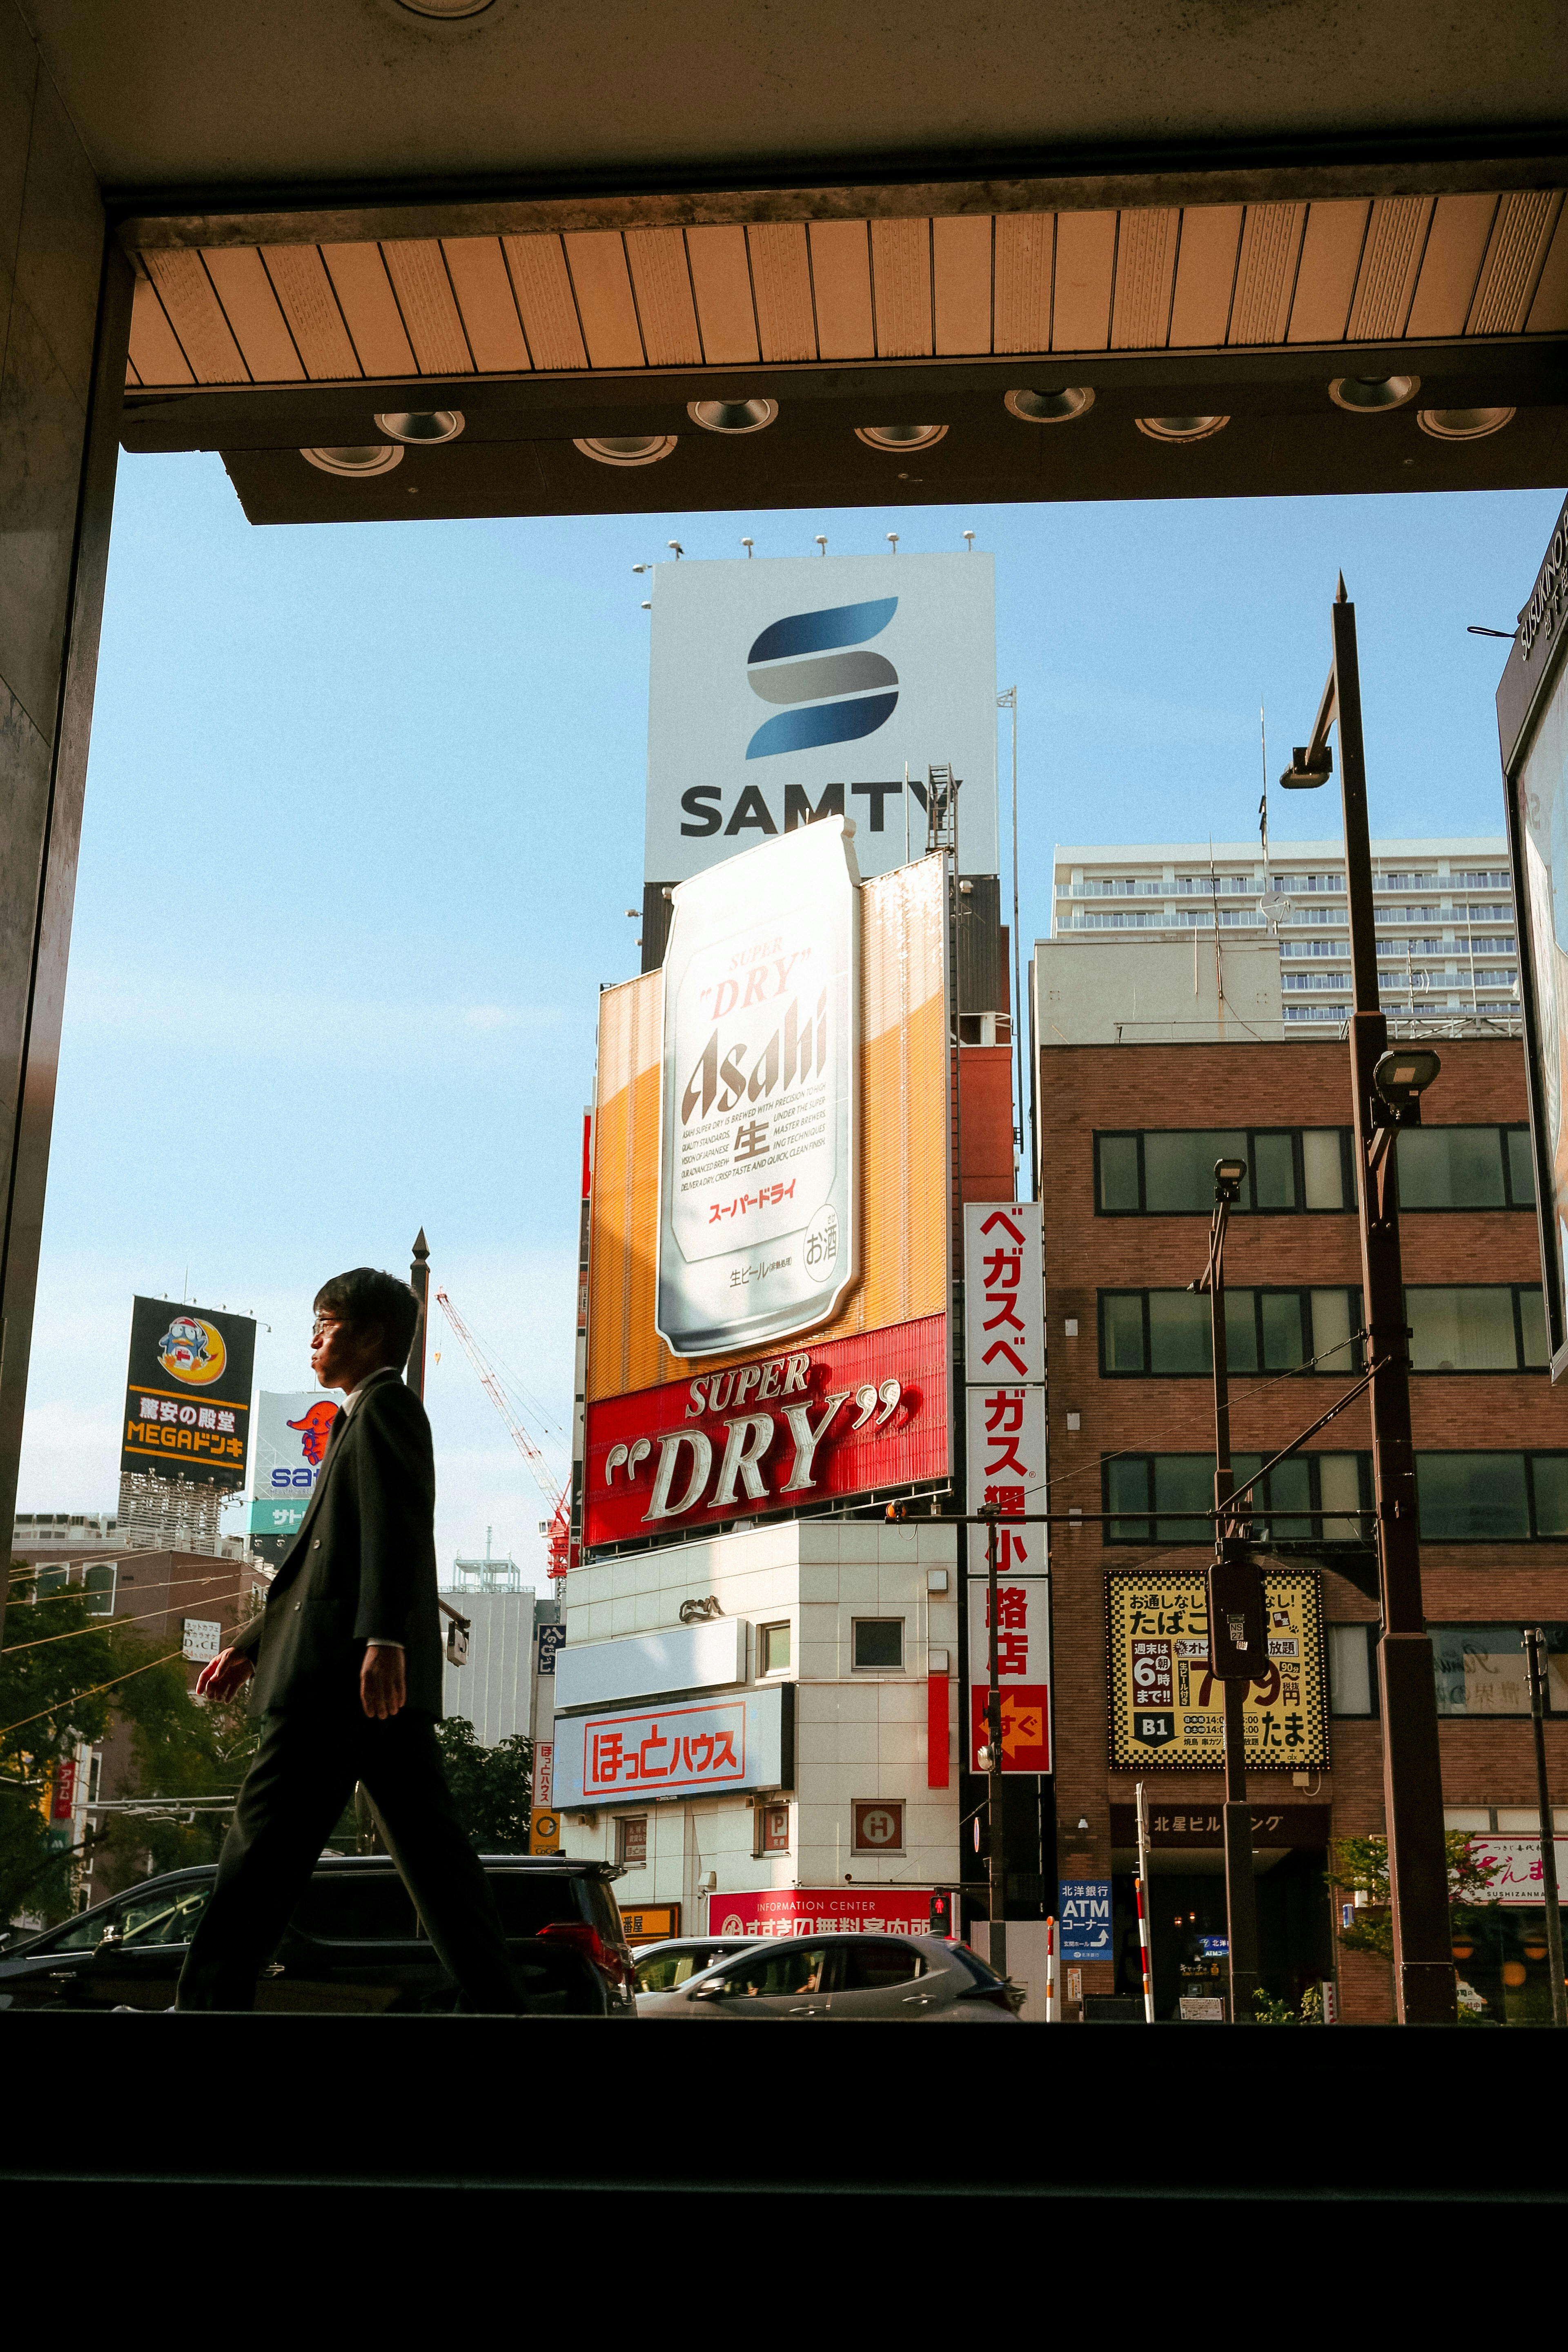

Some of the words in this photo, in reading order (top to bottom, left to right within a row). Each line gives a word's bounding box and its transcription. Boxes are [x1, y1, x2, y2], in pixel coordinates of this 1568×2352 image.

[1521, 530, 1562, 661] SUSUKINO
[680, 780, 964, 837] SAMTY
[728, 937, 783, 971] SUPER
[681, 985, 827, 1126] Asahi
[695, 1124, 711, 1135] SUPER
[713, 1119, 724, 1129] DRY
[725, 1117, 730, 1125] IS
[731, 1108, 756, 1123] BREWED
[757, 1101, 774, 1114] WITH
[775, 1091, 805, 1108] PRECISION
[774, 1107, 795, 1122] UNDER
[797, 1102, 808, 1114] THE
[773, 1120, 800, 1136] MASTER
[773, 1138, 786, 1150] ING
[787, 1123, 826, 1145] TECHNIQUES
[734, 1120, 770, 1162] 生
[715, 1170, 732, 1182] CRISP
[732, 1163, 751, 1177] TASTE
[751, 1159, 766, 1171] AND
[789, 1144, 808, 1157] CLEAN
[709, 1179, 797, 1224] スーパードライ
[806, 1224, 837, 1265] お酒
[685, 1353, 810, 1419] SUPER
[140, 1396, 235, 1433] 驚安の殿堂
[127, 1420, 243, 1458] MEGAドンキ
[1129, 1594, 1207, 1610] お通しなし
[1274, 1613, 1290, 1626] 個室
[1134, 1643, 1168, 1655] 週末は
[1189, 1642, 1208, 1654] オト
[1281, 1664, 1299, 1673] 90分
[1179, 1662, 1189, 1705] 生ビール付き
[1190, 1659, 1281, 1707] 79
[1283, 1682, 1300, 1690] 税抜
[1137, 1690, 1171, 1704] まで!!
[1143, 1719, 1168, 1736] B1
[1206, 1726, 1223, 1734] 14:0
[1262, 1711, 1305, 1747] たま
[592, 1724, 737, 1783] ほっとハウス
[540, 1746, 552, 1802] ほっとハウス
[775, 1815, 784, 1833] P
[1154, 1816, 1283, 1831] 北星ビルング
[1062, 1886, 1108, 1896] 北洋銀行
[757, 1901, 824, 1912] INFORMATION
[830, 1901, 876, 1911] CENTER
[1062, 1900, 1109, 1918] ATM
[623, 1915, 643, 1933] 番屋
[746, 1918, 931, 1936] すすきの無料案内所
[1062, 1919, 1109, 1931] コーナー
